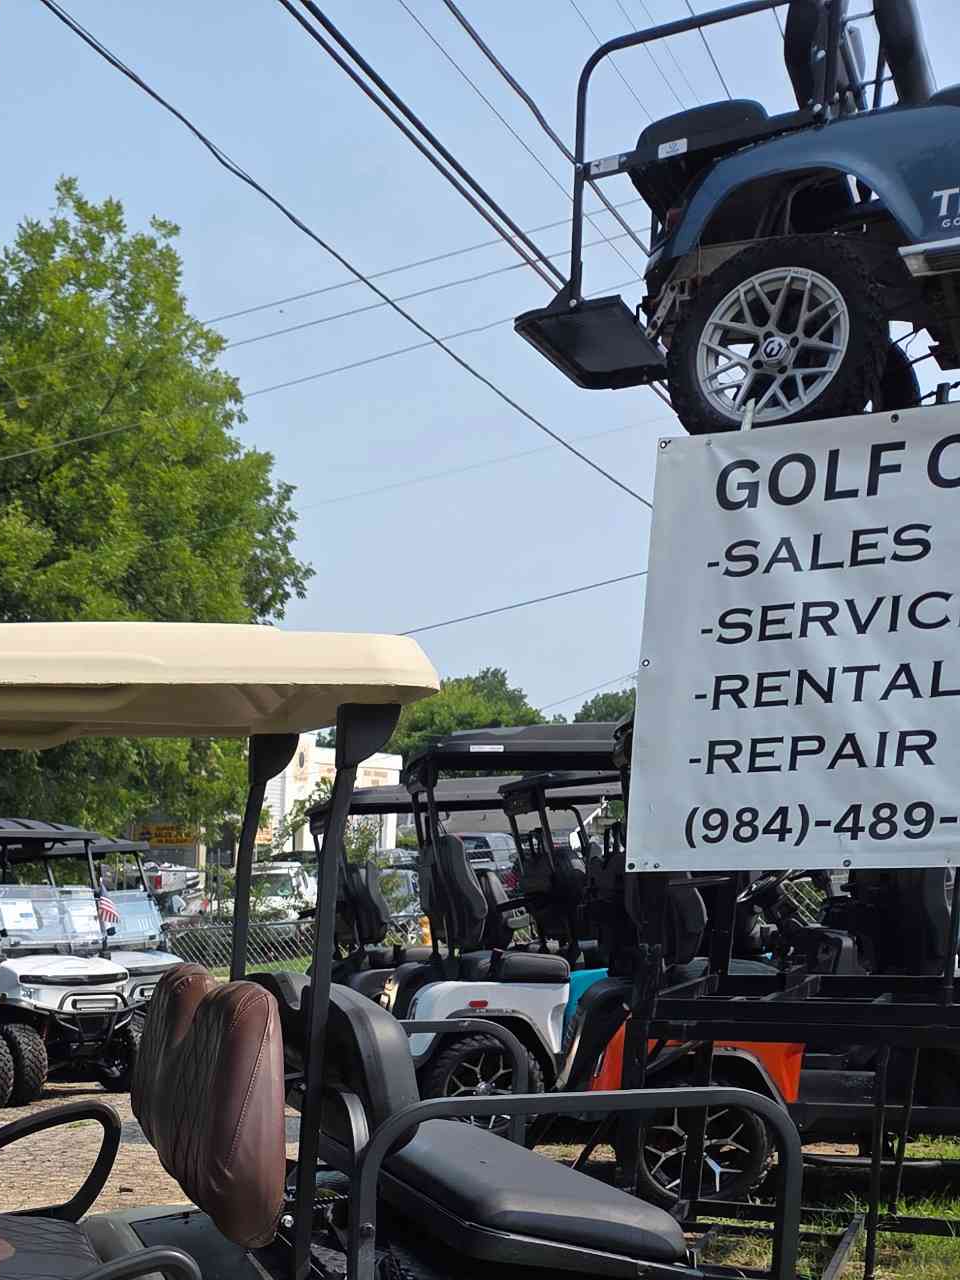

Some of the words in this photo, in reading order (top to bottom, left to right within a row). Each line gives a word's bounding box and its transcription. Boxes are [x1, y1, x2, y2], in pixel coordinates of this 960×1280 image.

[715, 440, 906, 511] GOLF
[707, 523, 932, 578] -SALES
[700, 591, 960, 644] -SERVIC
[694, 660, 960, 710] -RENTAL
[689, 729, 938, 774] -REPAIR
[685, 801, 958, 848] (984)-489-
